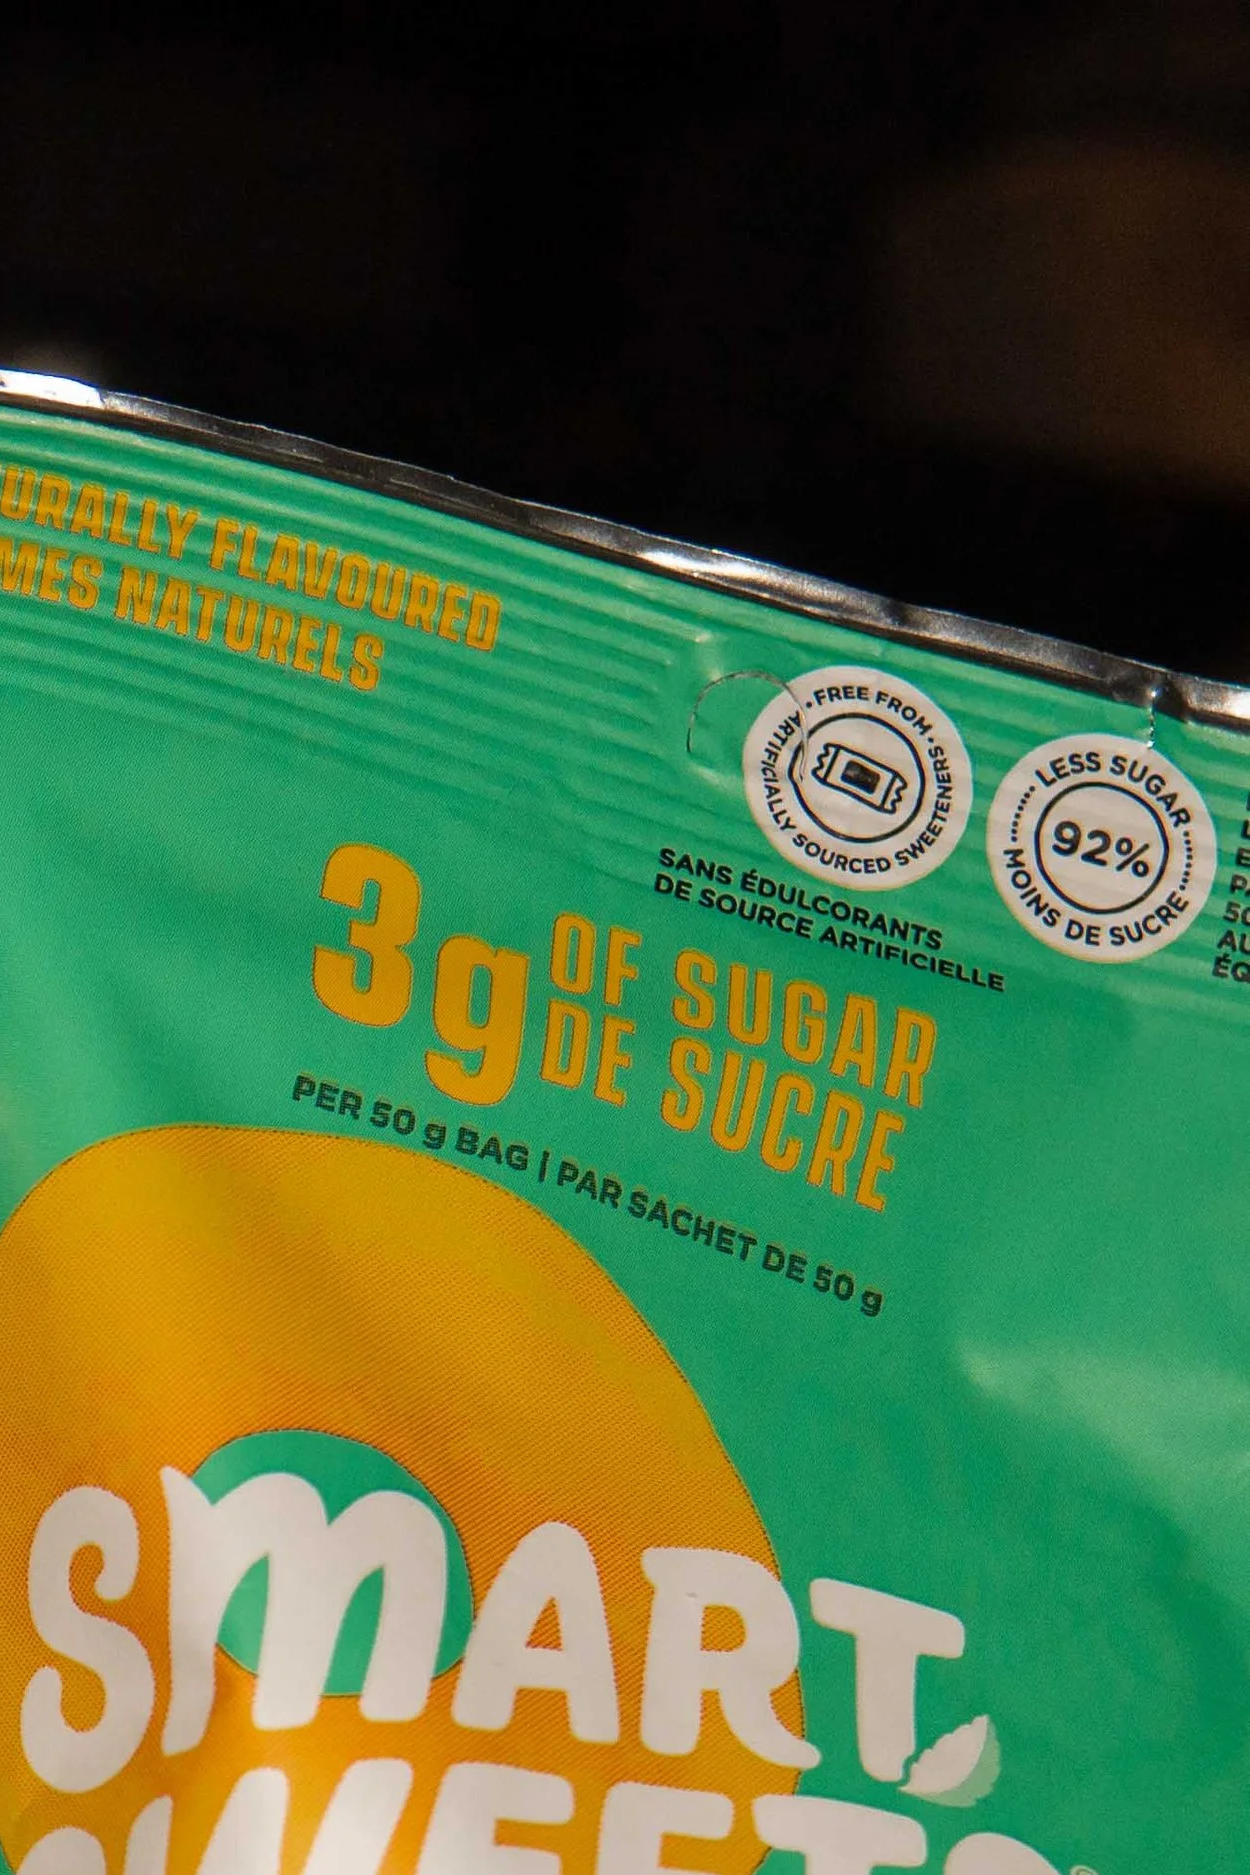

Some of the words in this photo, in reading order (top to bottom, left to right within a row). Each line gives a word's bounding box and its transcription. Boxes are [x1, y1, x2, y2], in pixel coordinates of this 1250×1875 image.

[114, 566, 386, 692] NATURELS
[208, 517, 502, 652] FLAVOURED
[813, 685, 870, 706] FREE
[875, 690, 934, 736] FROM
[760, 709, 805, 832] ARTIFICIALLY
[791, 832, 892, 875] SOURCED
[893, 744, 955, 867] SWEETENERS
[1034, 751, 1102, 788] LESS
[1109, 754, 1192, 829] SUGAR
[1051, 820, 1151, 878] 92%
[654, 872, 693, 902] DE
[699, 887, 815, 940] SOURCE
[818, 925, 1006, 993] ARTIFICIELLE
[658, 847, 733, 887] SANS
[739, 868, 944, 952] ÉDULCORANTS
[1002, 848, 1062, 928] MOINS
[1064, 918, 1102, 947] DE
[1108, 890, 1190, 947] SUCRE
[549, 910, 642, 1006] OF
[671, 948, 938, 1109] SUGAR
[539, 998, 636, 1108] DE
[658, 1035, 905, 1214] SUCRE
[291, 1073, 363, 1121] PER
[369, 1099, 417, 1136] 50
[422, 1121, 448, 1150] g
[454, 1124, 530, 1171] BAG
[556, 1158, 623, 1209] PAR
[626, 1187, 758, 1262] SACHET
[760, 1242, 809, 1285] DE
[812, 1263, 856, 1302] 50
[859, 1287, 884, 1318] g
[20, 1465, 968, 1795] SMART
